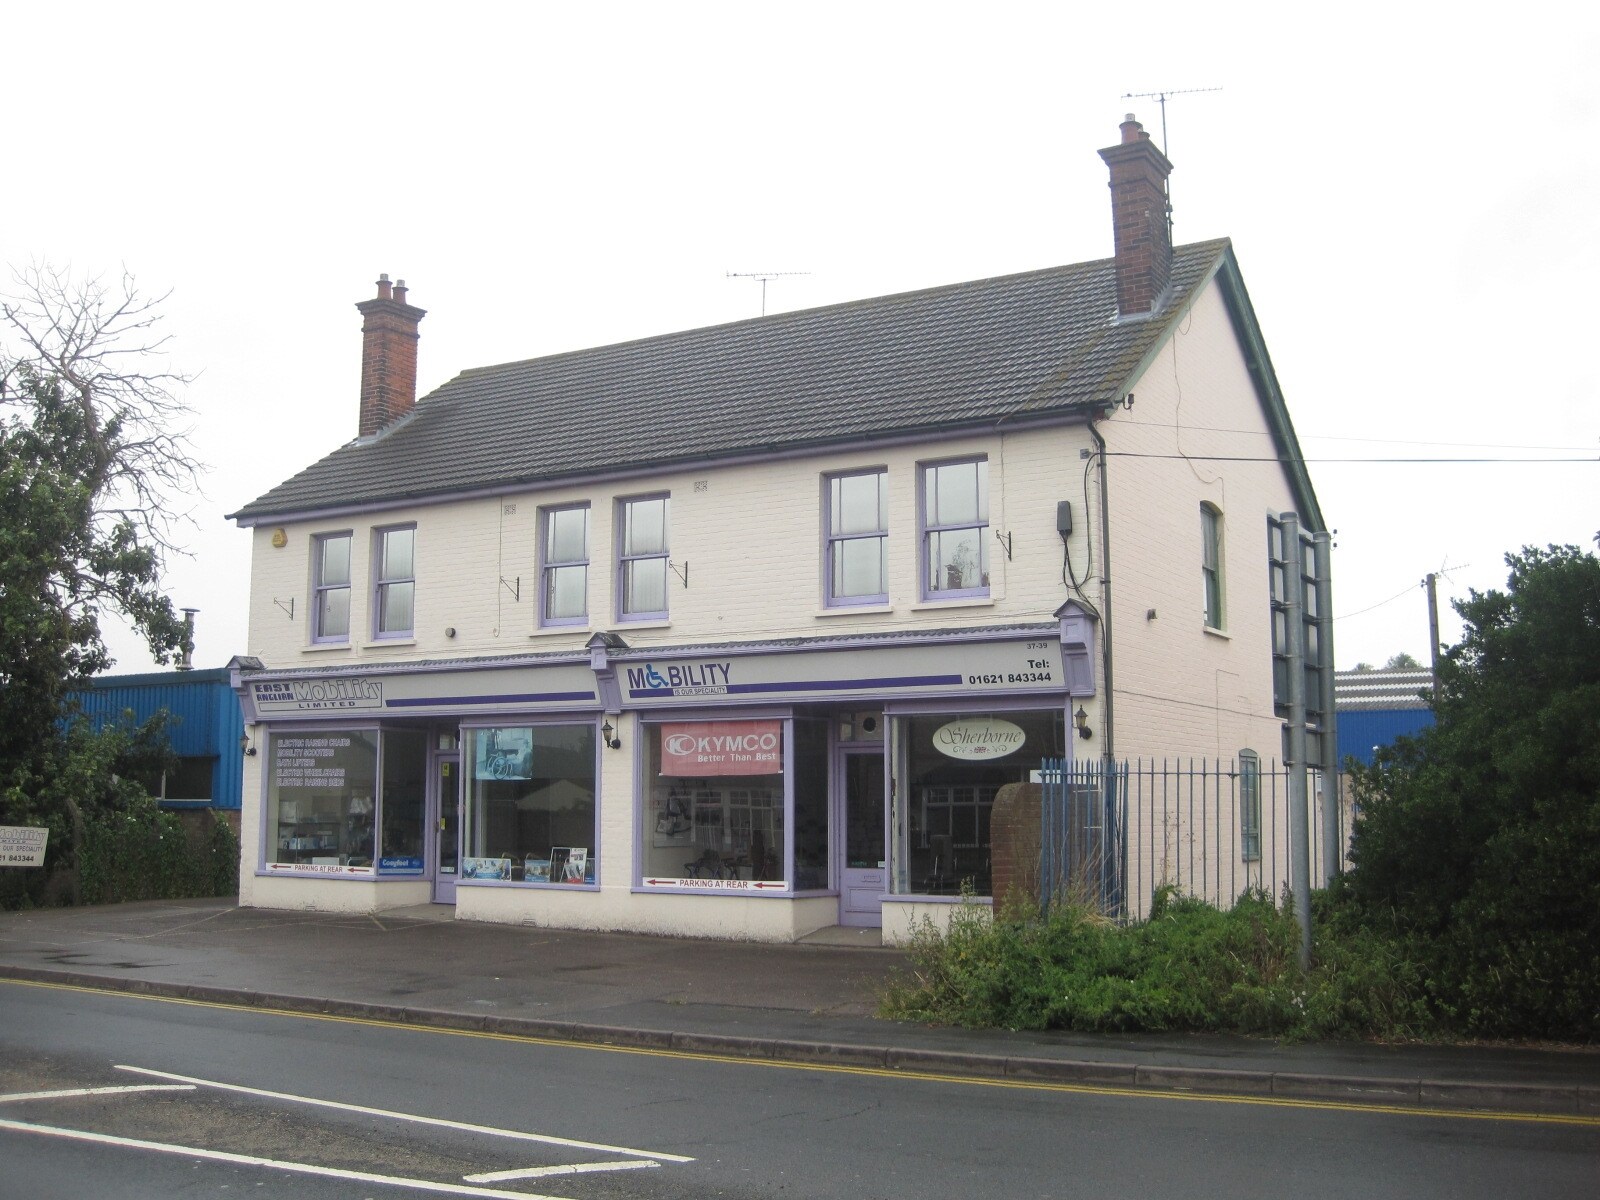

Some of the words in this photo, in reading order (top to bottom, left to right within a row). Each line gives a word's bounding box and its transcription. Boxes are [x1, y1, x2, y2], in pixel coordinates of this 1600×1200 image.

[1027, 659, 1050, 668] Tel:
[969, 674, 1003, 685] 01621
[1008, 672, 1051, 683] 843344
[254, 683, 291, 692] EAST
[293, 679, 383, 700] Mobility
[695, 686, 726, 694] SPECIALITY
[256, 692, 294, 701] ANGLIAN
[298, 701, 356, 709] LIMITED
[940, 727, 1022, 744] Sherborne
[277, 739, 304, 748] ELECTRIC
[698, 733, 777, 752] KYMCO
[277, 748, 303, 757] MOBILITY
[698, 754, 726, 762] Better
[730, 753, 752, 762] Than
[756, 752, 776, 760] Best
[276, 768, 304, 777] ELECTRIC
[276, 777, 304, 787] ELECTRIC
[294, 864, 318, 872] PARKING
[327, 865, 344, 873] REAR
[679, 879, 713, 888] PARKING
